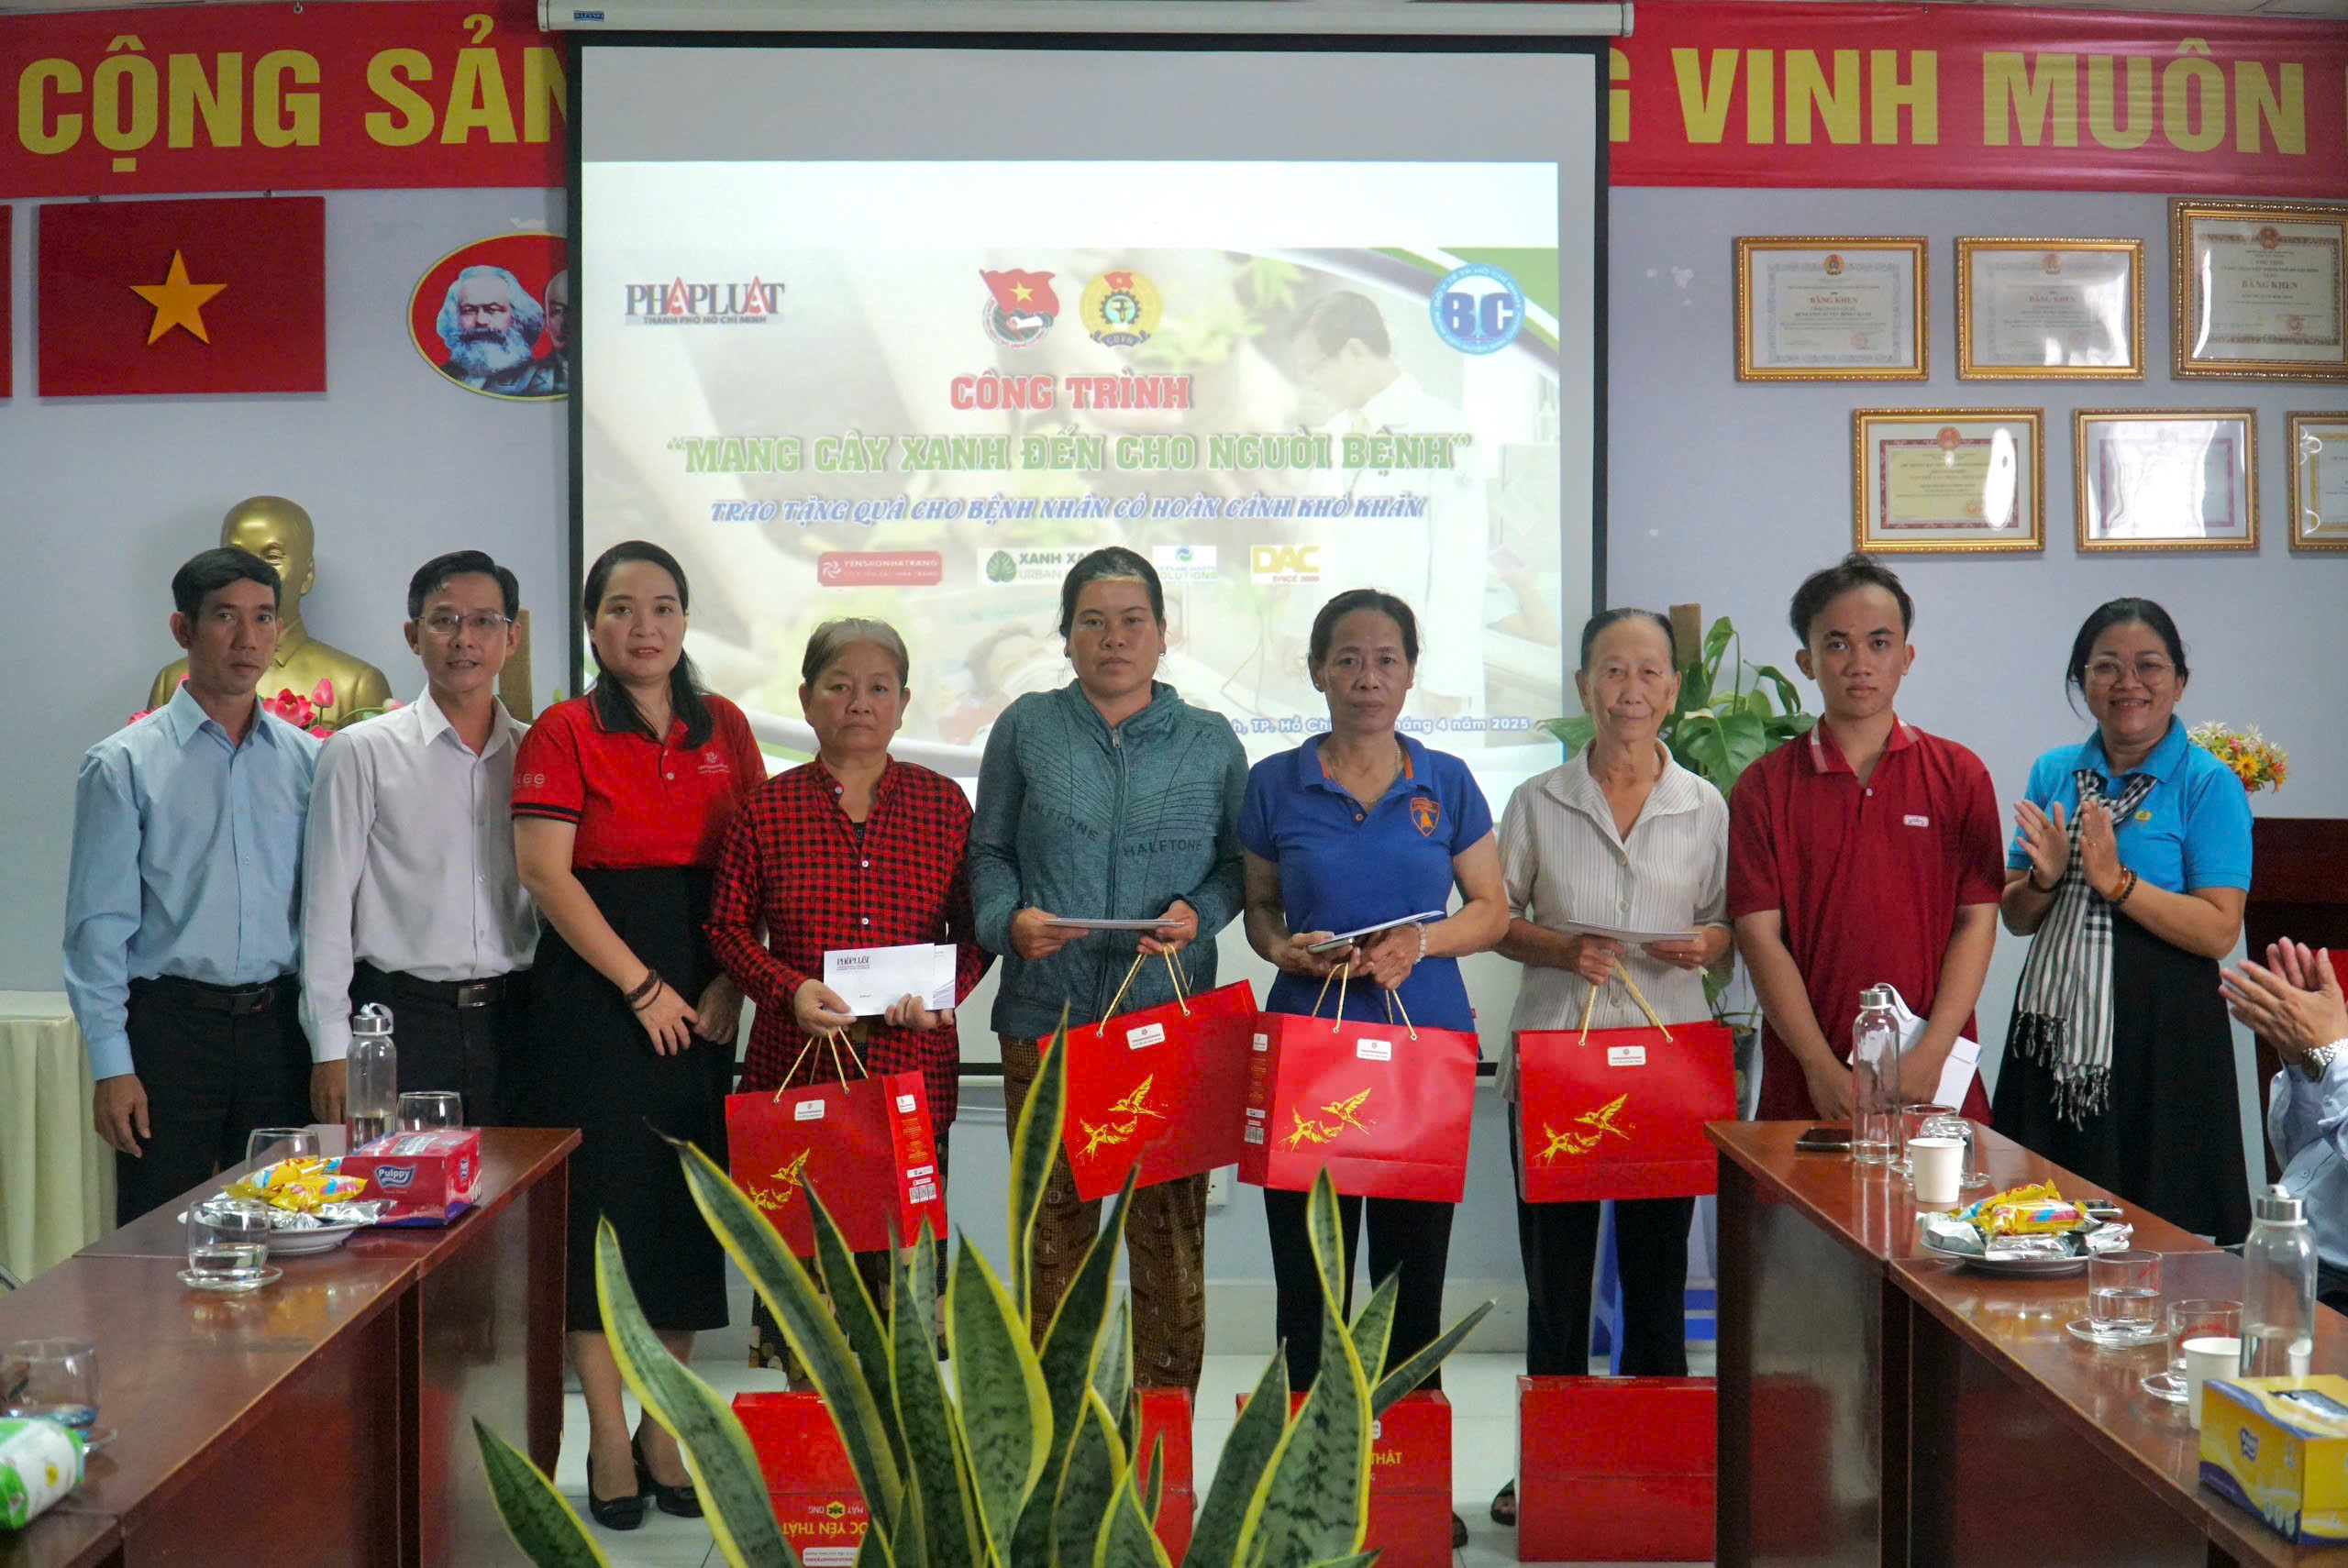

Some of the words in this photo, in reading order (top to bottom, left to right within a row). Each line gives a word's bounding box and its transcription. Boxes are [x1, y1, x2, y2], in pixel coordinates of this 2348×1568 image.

[17, 35, 321, 172] CỘNG
[1671, 47, 1938, 146] VINH
[1983, 37, 2308, 155] MUÔN
[950, 370, 1054, 410] CÔNG
[1065, 368, 1191, 410] TRÌNH
[814, 428, 891, 473] CÂY
[900, 435, 1008, 470] XANH
[1020, 425, 1105, 470] ĐẾN
[1115, 435, 1196, 470] CHO
[1207, 425, 1331, 470] NGƯỜI
[711, 500, 779, 522] TRAO
[784, 493, 850, 525] TẶNG
[854, 492, 908, 525] QUÀ
[911, 498, 963, 521] CHO
[968, 492, 1036, 525] BỆNH
[1040, 492, 1110, 520] NHÂN
[1114, 493, 1147, 520] CÓ
[1152, 492, 1222, 520] HOÀN
[1225, 491, 1293, 519] CẢNH
[1297, 491, 1353, 519] KHÓ
[1354, 491, 1427, 519] KHĂN
[1020, 552, 1062, 565] XANH
[1254, 546, 1321, 573] DAC
[1019, 569, 1062, 580] URBAN
[1158, 571, 1218, 580] OLUTIONS
[1251, 718, 1276, 733] TP.
[1436, 717, 1447, 731] 4
[1451, 716, 1487, 731] năm
[1491, 717, 1530, 731] 2025
[378, 1168, 410, 1179] Pulppy
